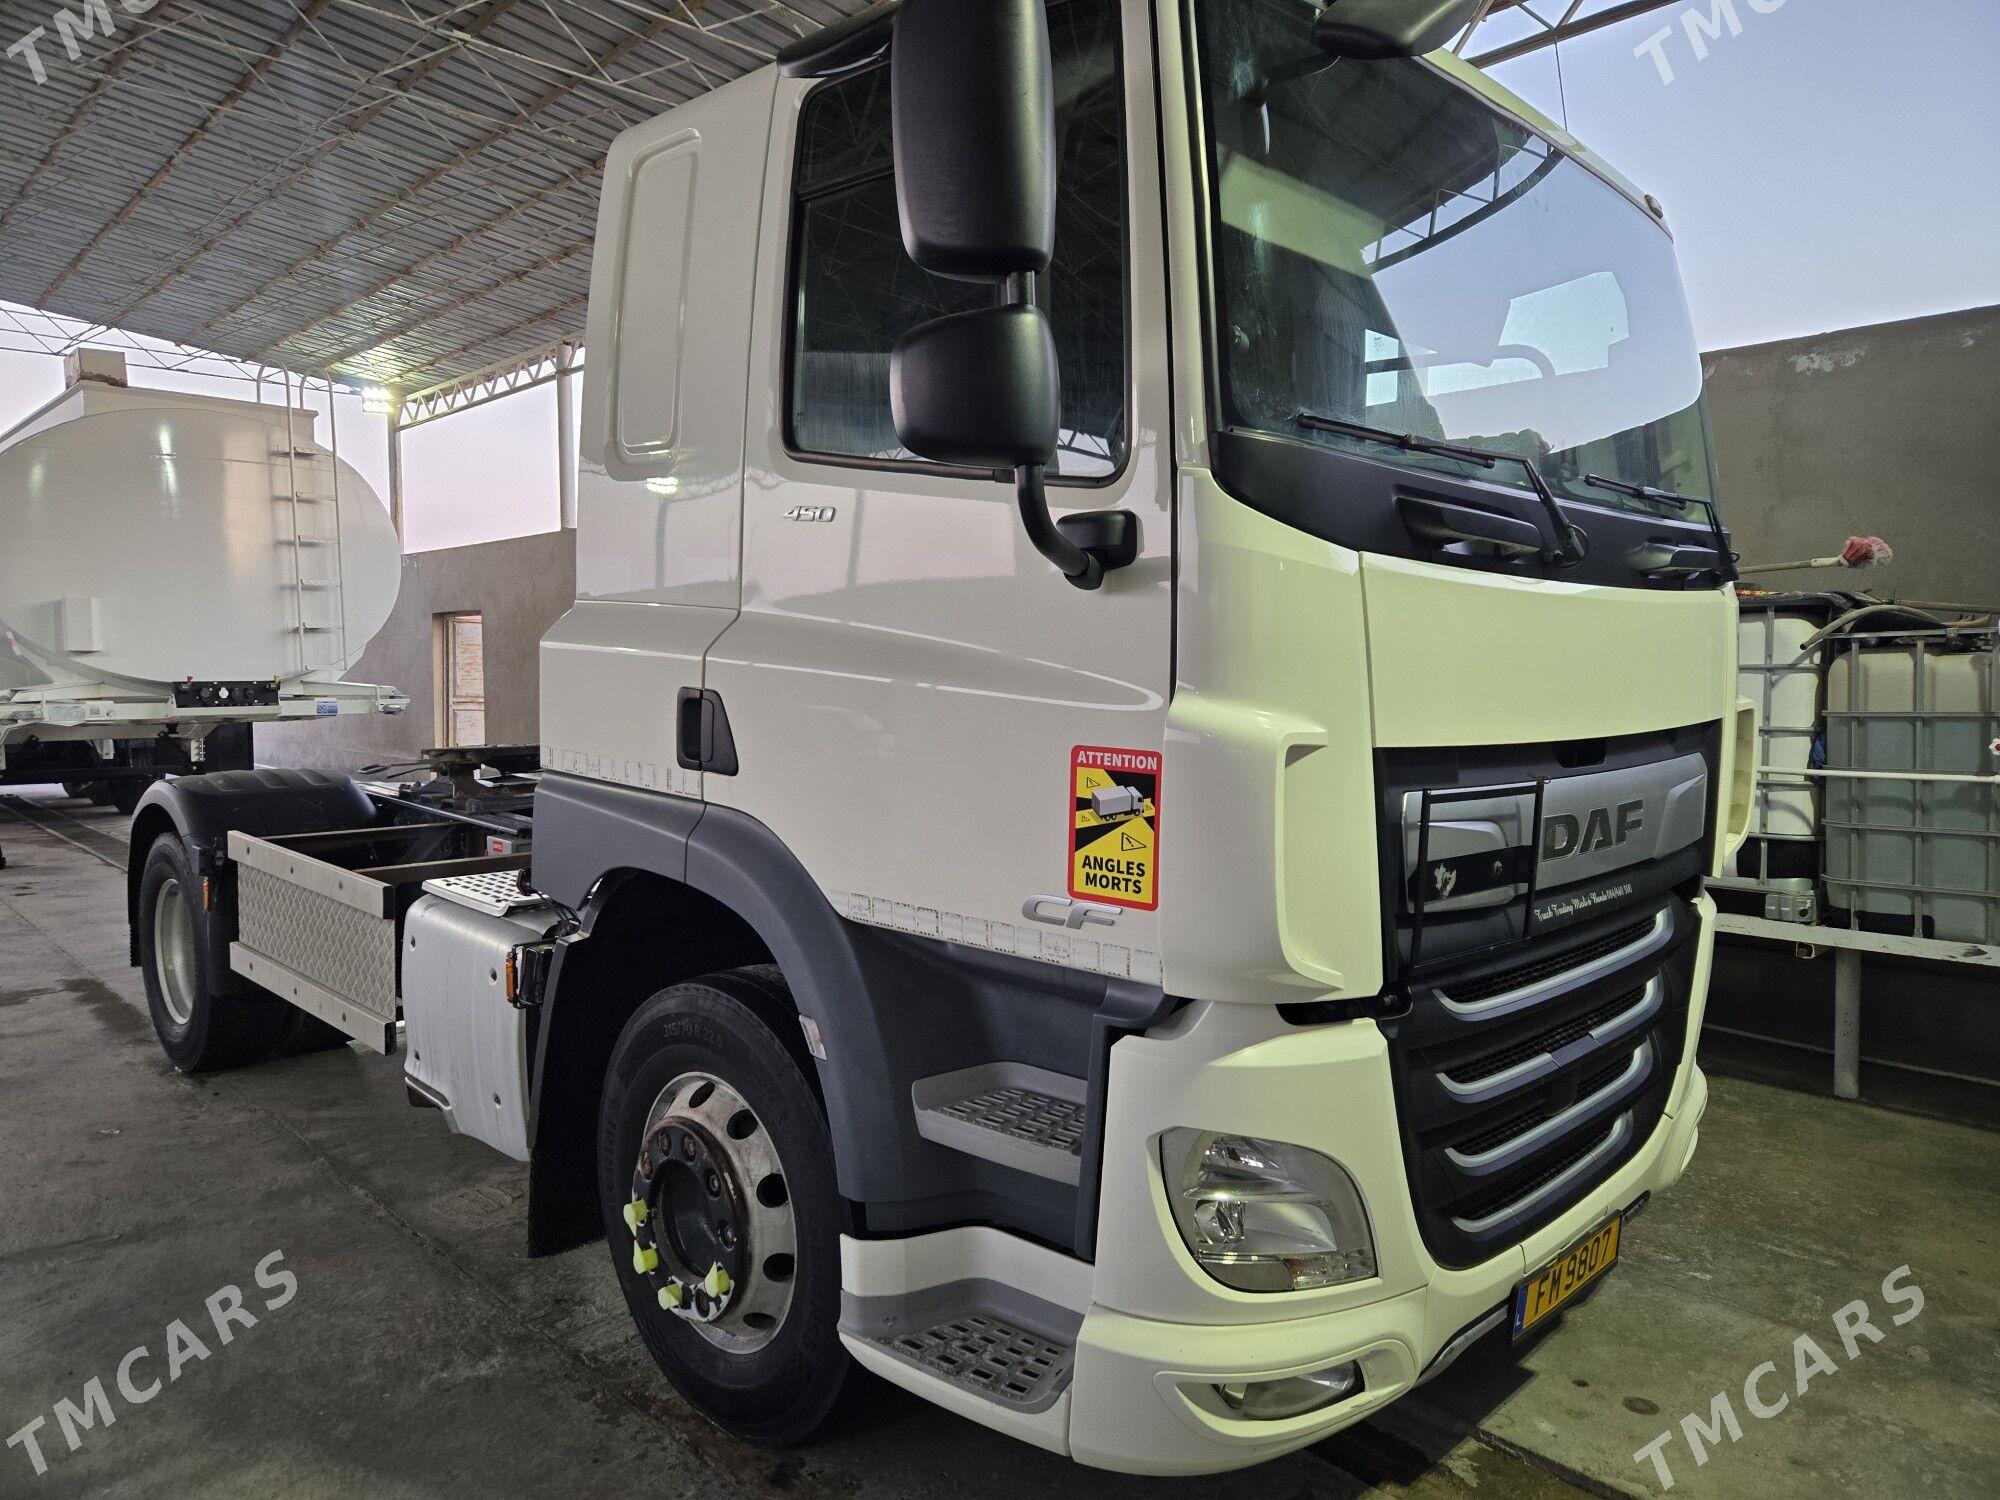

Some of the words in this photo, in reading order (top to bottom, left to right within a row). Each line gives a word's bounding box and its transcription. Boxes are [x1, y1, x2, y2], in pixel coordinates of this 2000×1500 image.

[783, 505, 836, 522] 450
[1077, 750, 1158, 770] ATTENTION
[1540, 799, 1644, 862] DAF
[1082, 854, 1146, 878] ANGLES
[1085, 871, 1142, 895] MORTS
[1021, 894, 1123, 930] CF
